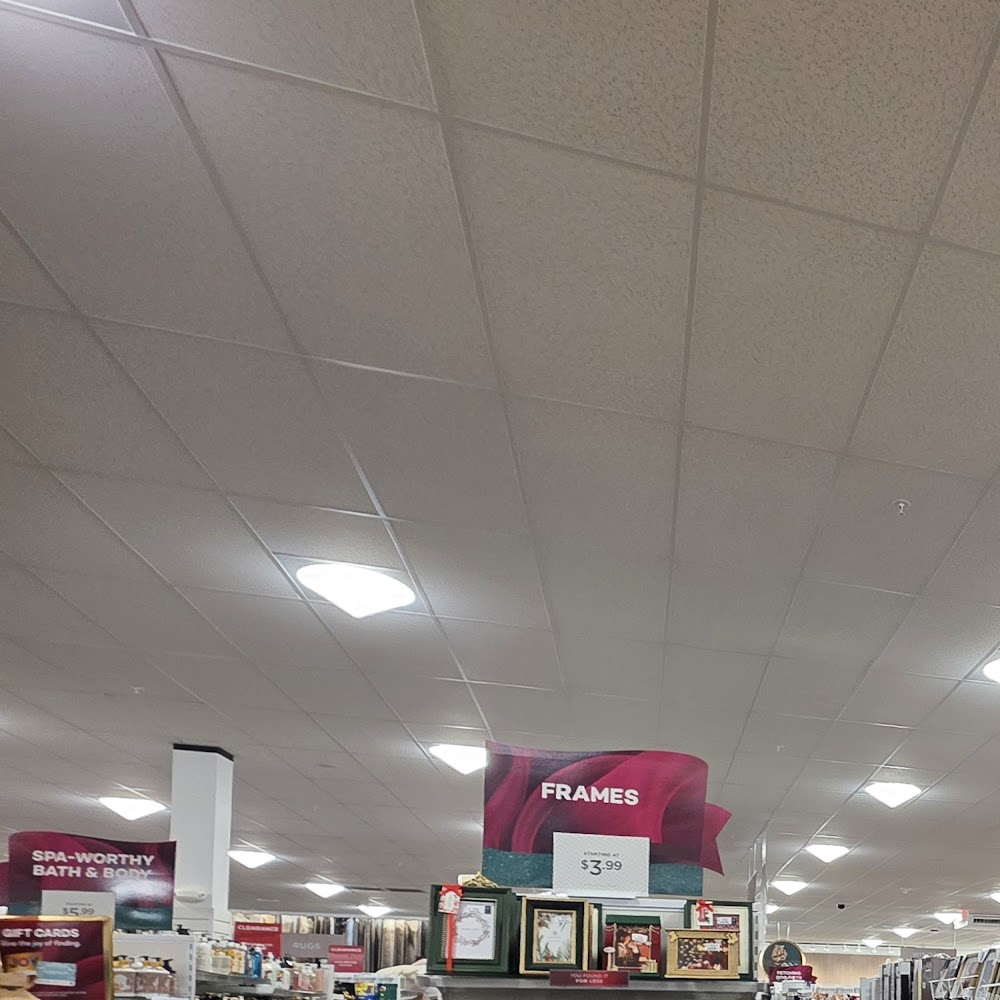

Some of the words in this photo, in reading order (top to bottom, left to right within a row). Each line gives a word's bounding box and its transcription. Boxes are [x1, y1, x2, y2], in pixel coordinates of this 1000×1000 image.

[541, 782, 639, 806] FRAMES
[32, 850, 155, 866] SPA-WORTHY
[33, 865, 82, 878] BATH
[85, 867, 98, 879] &
[103, 867, 152, 879] BODY
[581, 859, 622, 876] $3.99
[2, 928, 31, 938] GIFT
[34, 928, 80, 938] CARDS
[293, 942, 321, 950] RUGS
